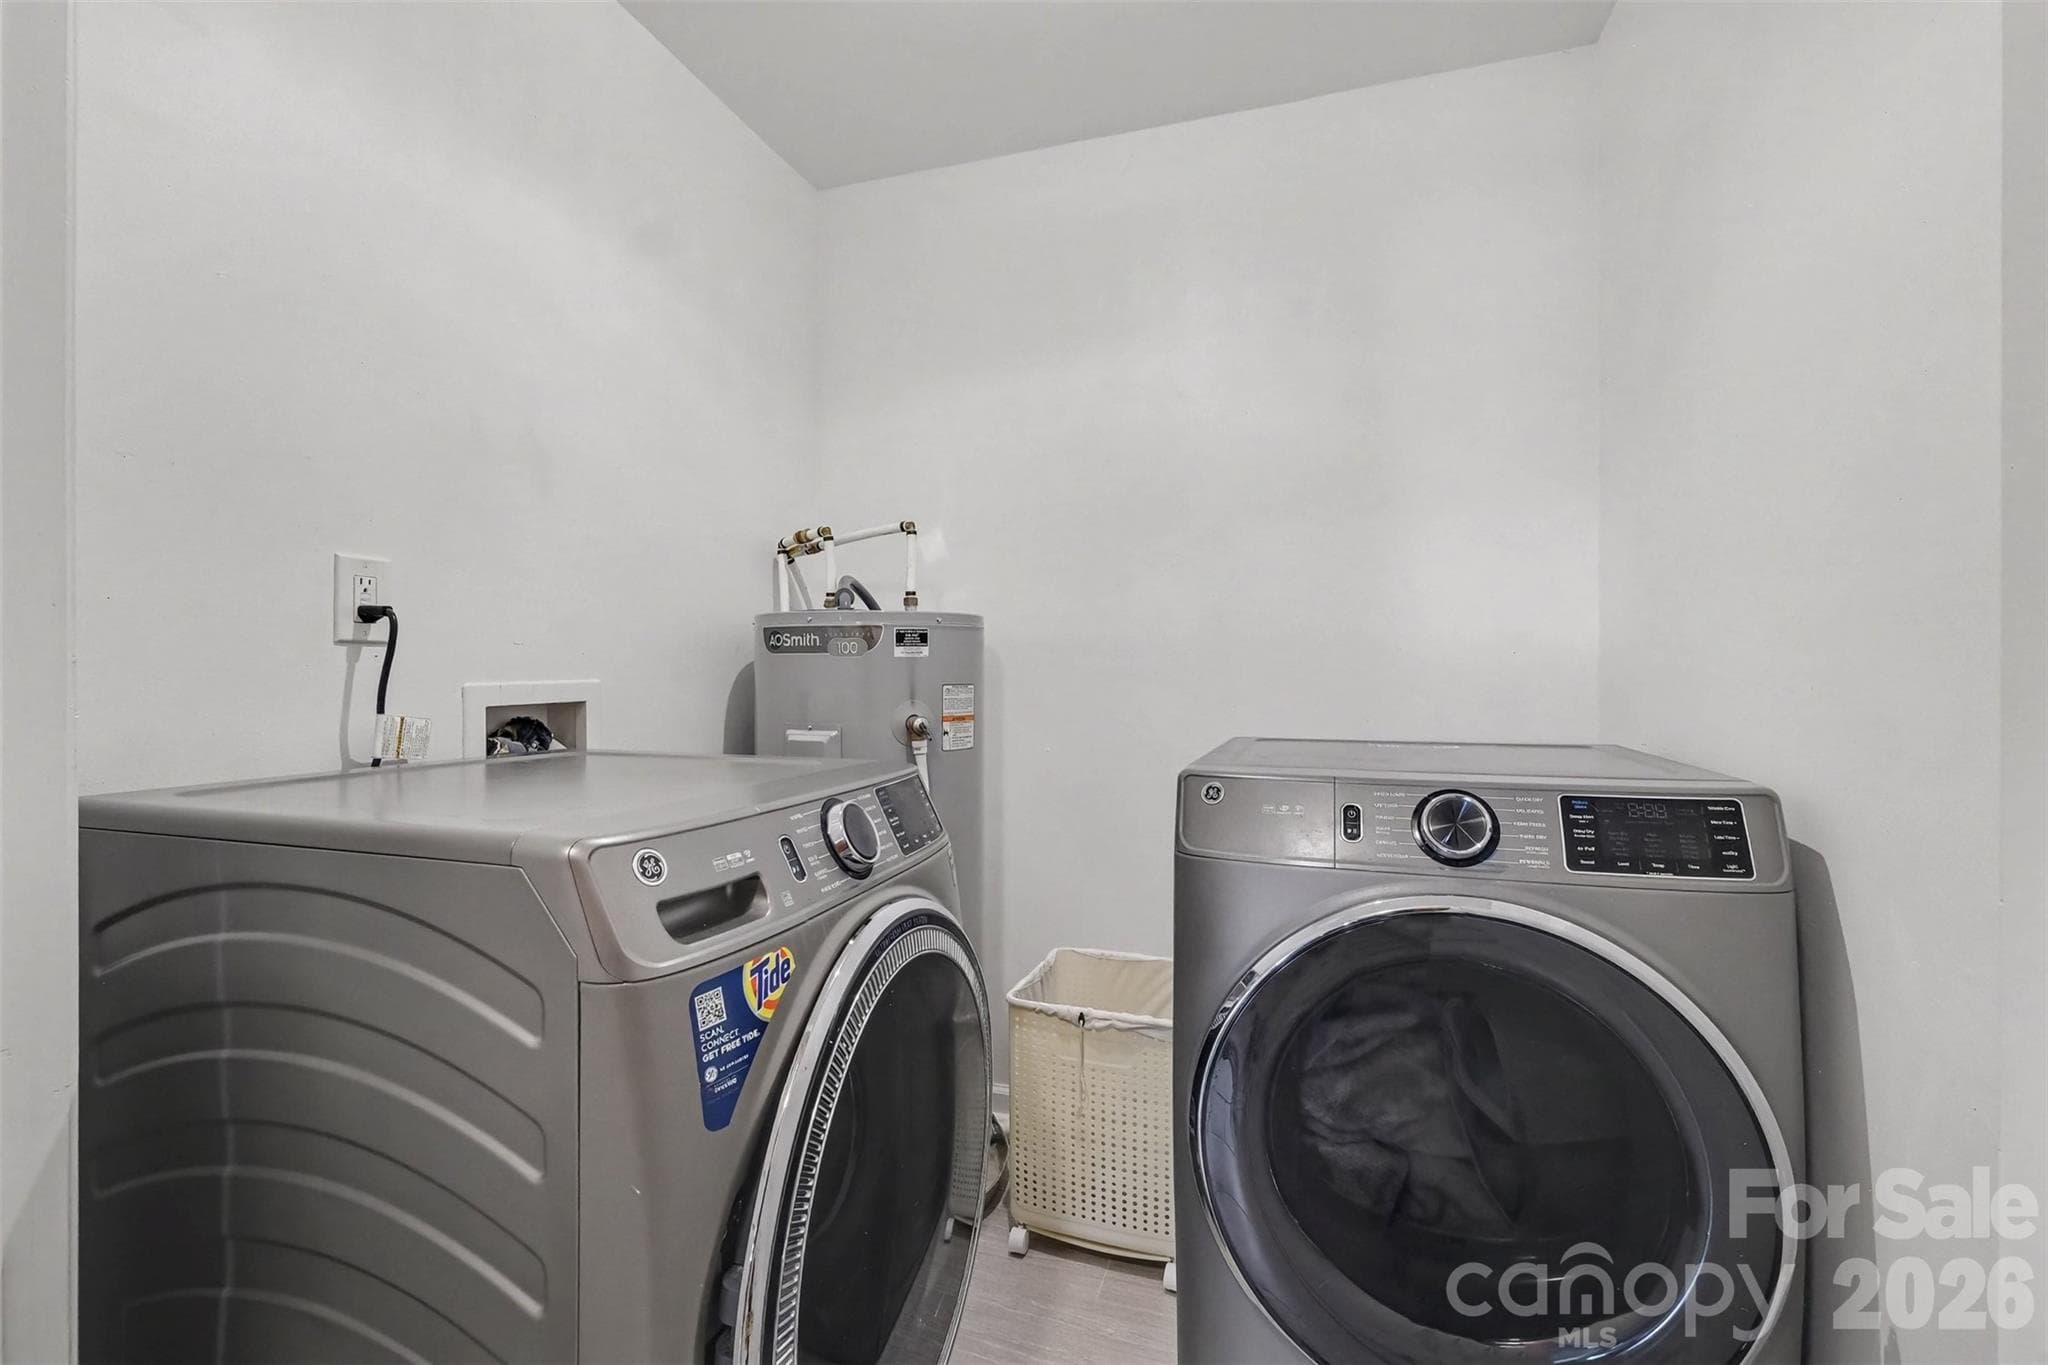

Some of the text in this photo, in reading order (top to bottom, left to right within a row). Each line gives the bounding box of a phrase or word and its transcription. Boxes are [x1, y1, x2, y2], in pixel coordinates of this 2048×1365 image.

[837, 641, 858, 655] 100
[750, 953, 791, 1011] Tide
[702, 1048, 719, 1063] GET
[721, 1037, 741, 1054] FREE
